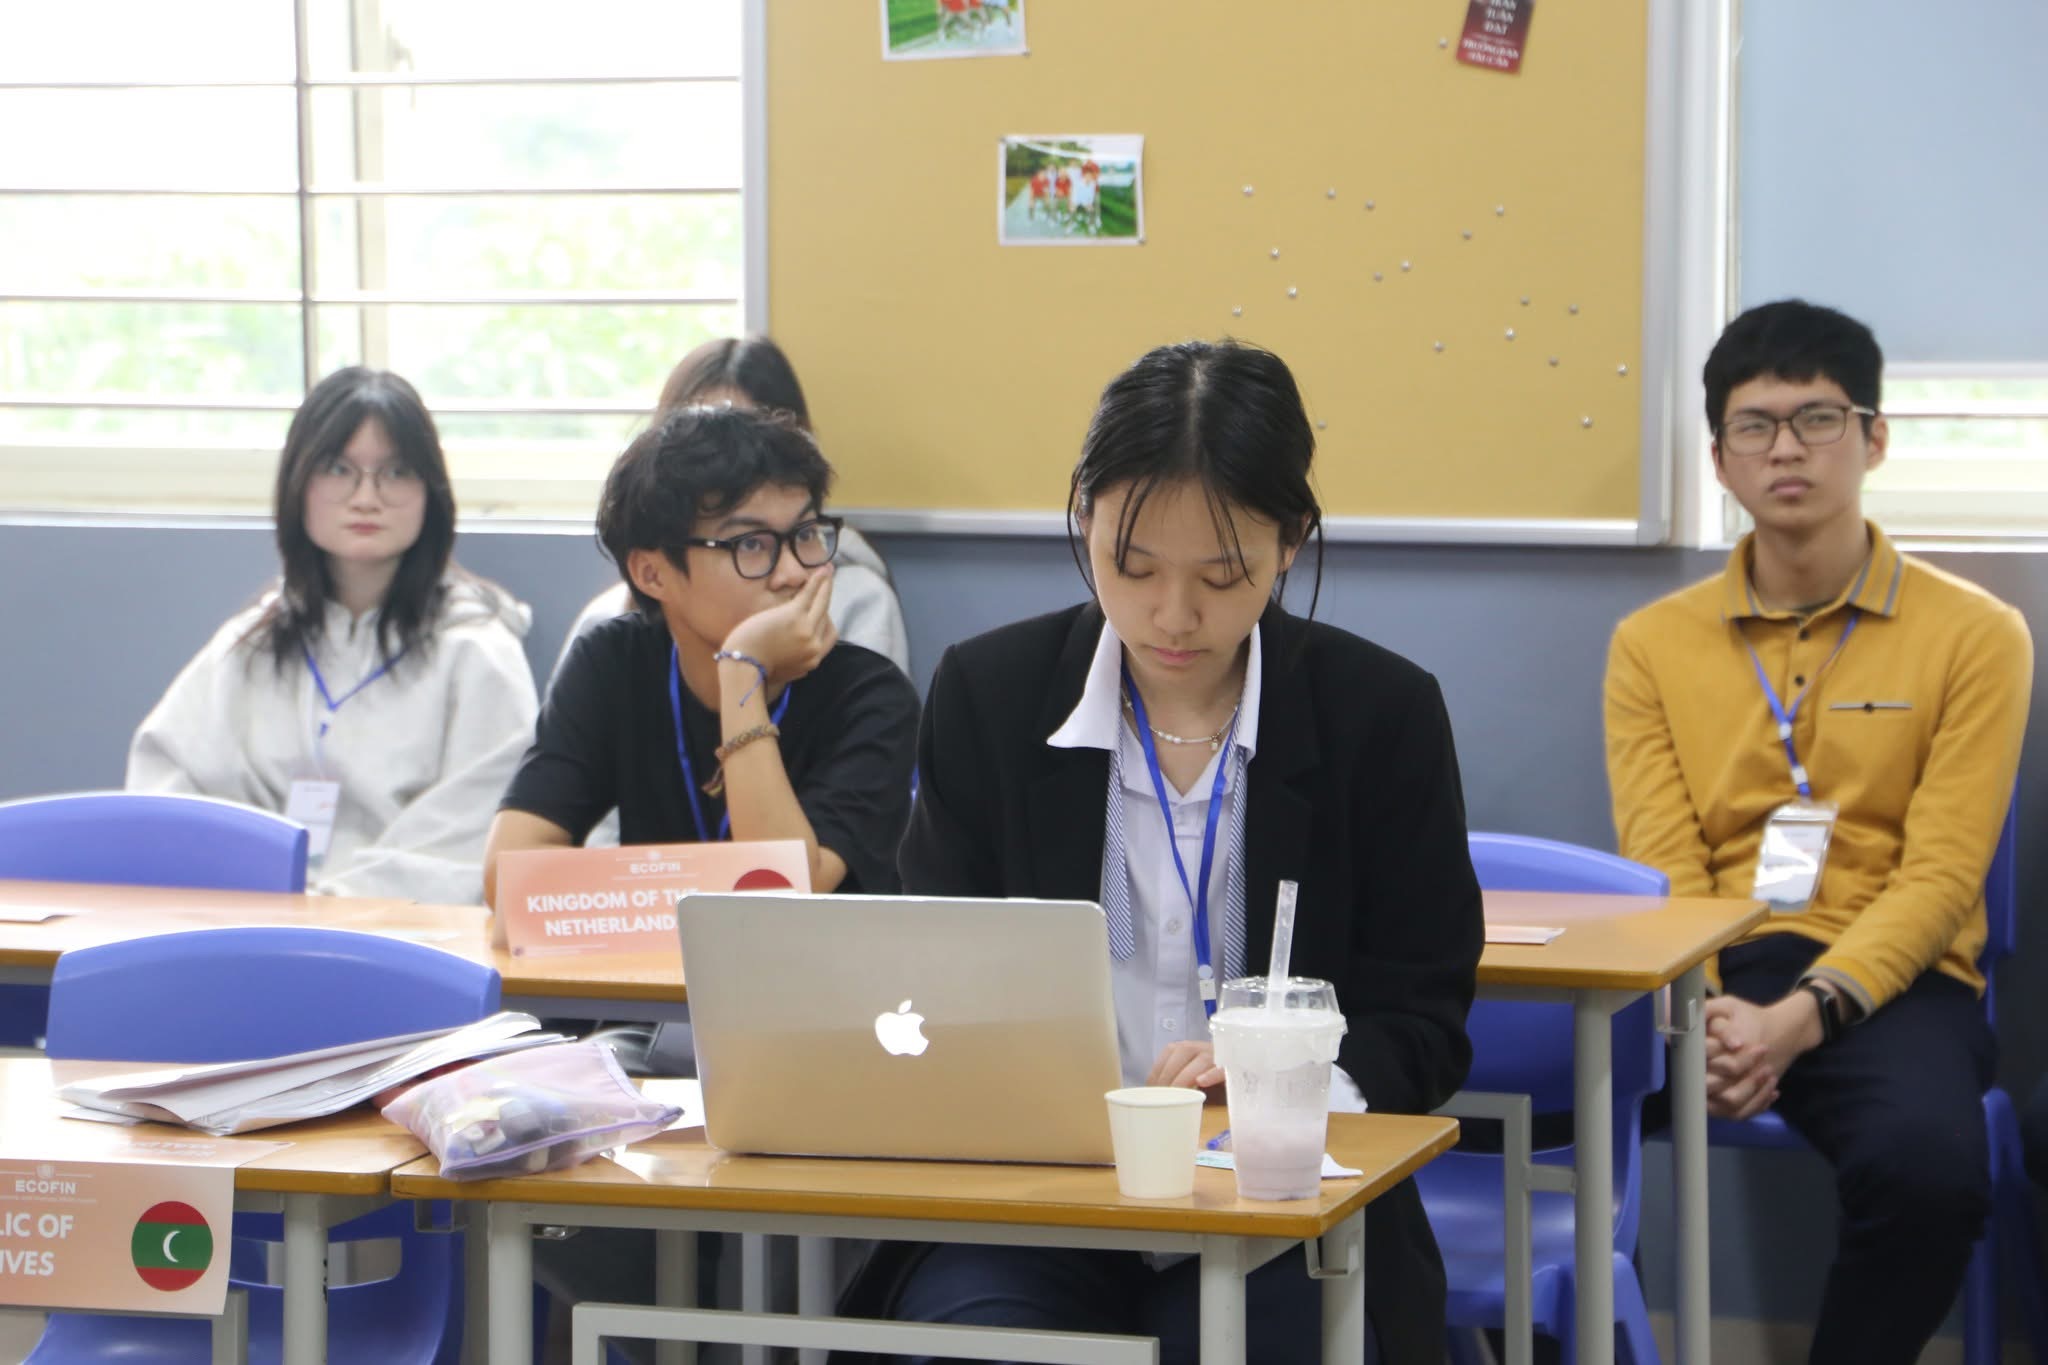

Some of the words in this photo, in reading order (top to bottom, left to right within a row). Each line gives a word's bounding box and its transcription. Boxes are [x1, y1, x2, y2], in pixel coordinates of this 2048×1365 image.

[630, 863, 681, 874] ECOFIN
[527, 891, 628, 912] KINGDOM
[631, 889, 658, 907] OF
[545, 914, 678, 936] NETHERLAND
[15, 1180, 76, 1194] ECOFIN
[38, 1214, 74, 1239] OF
